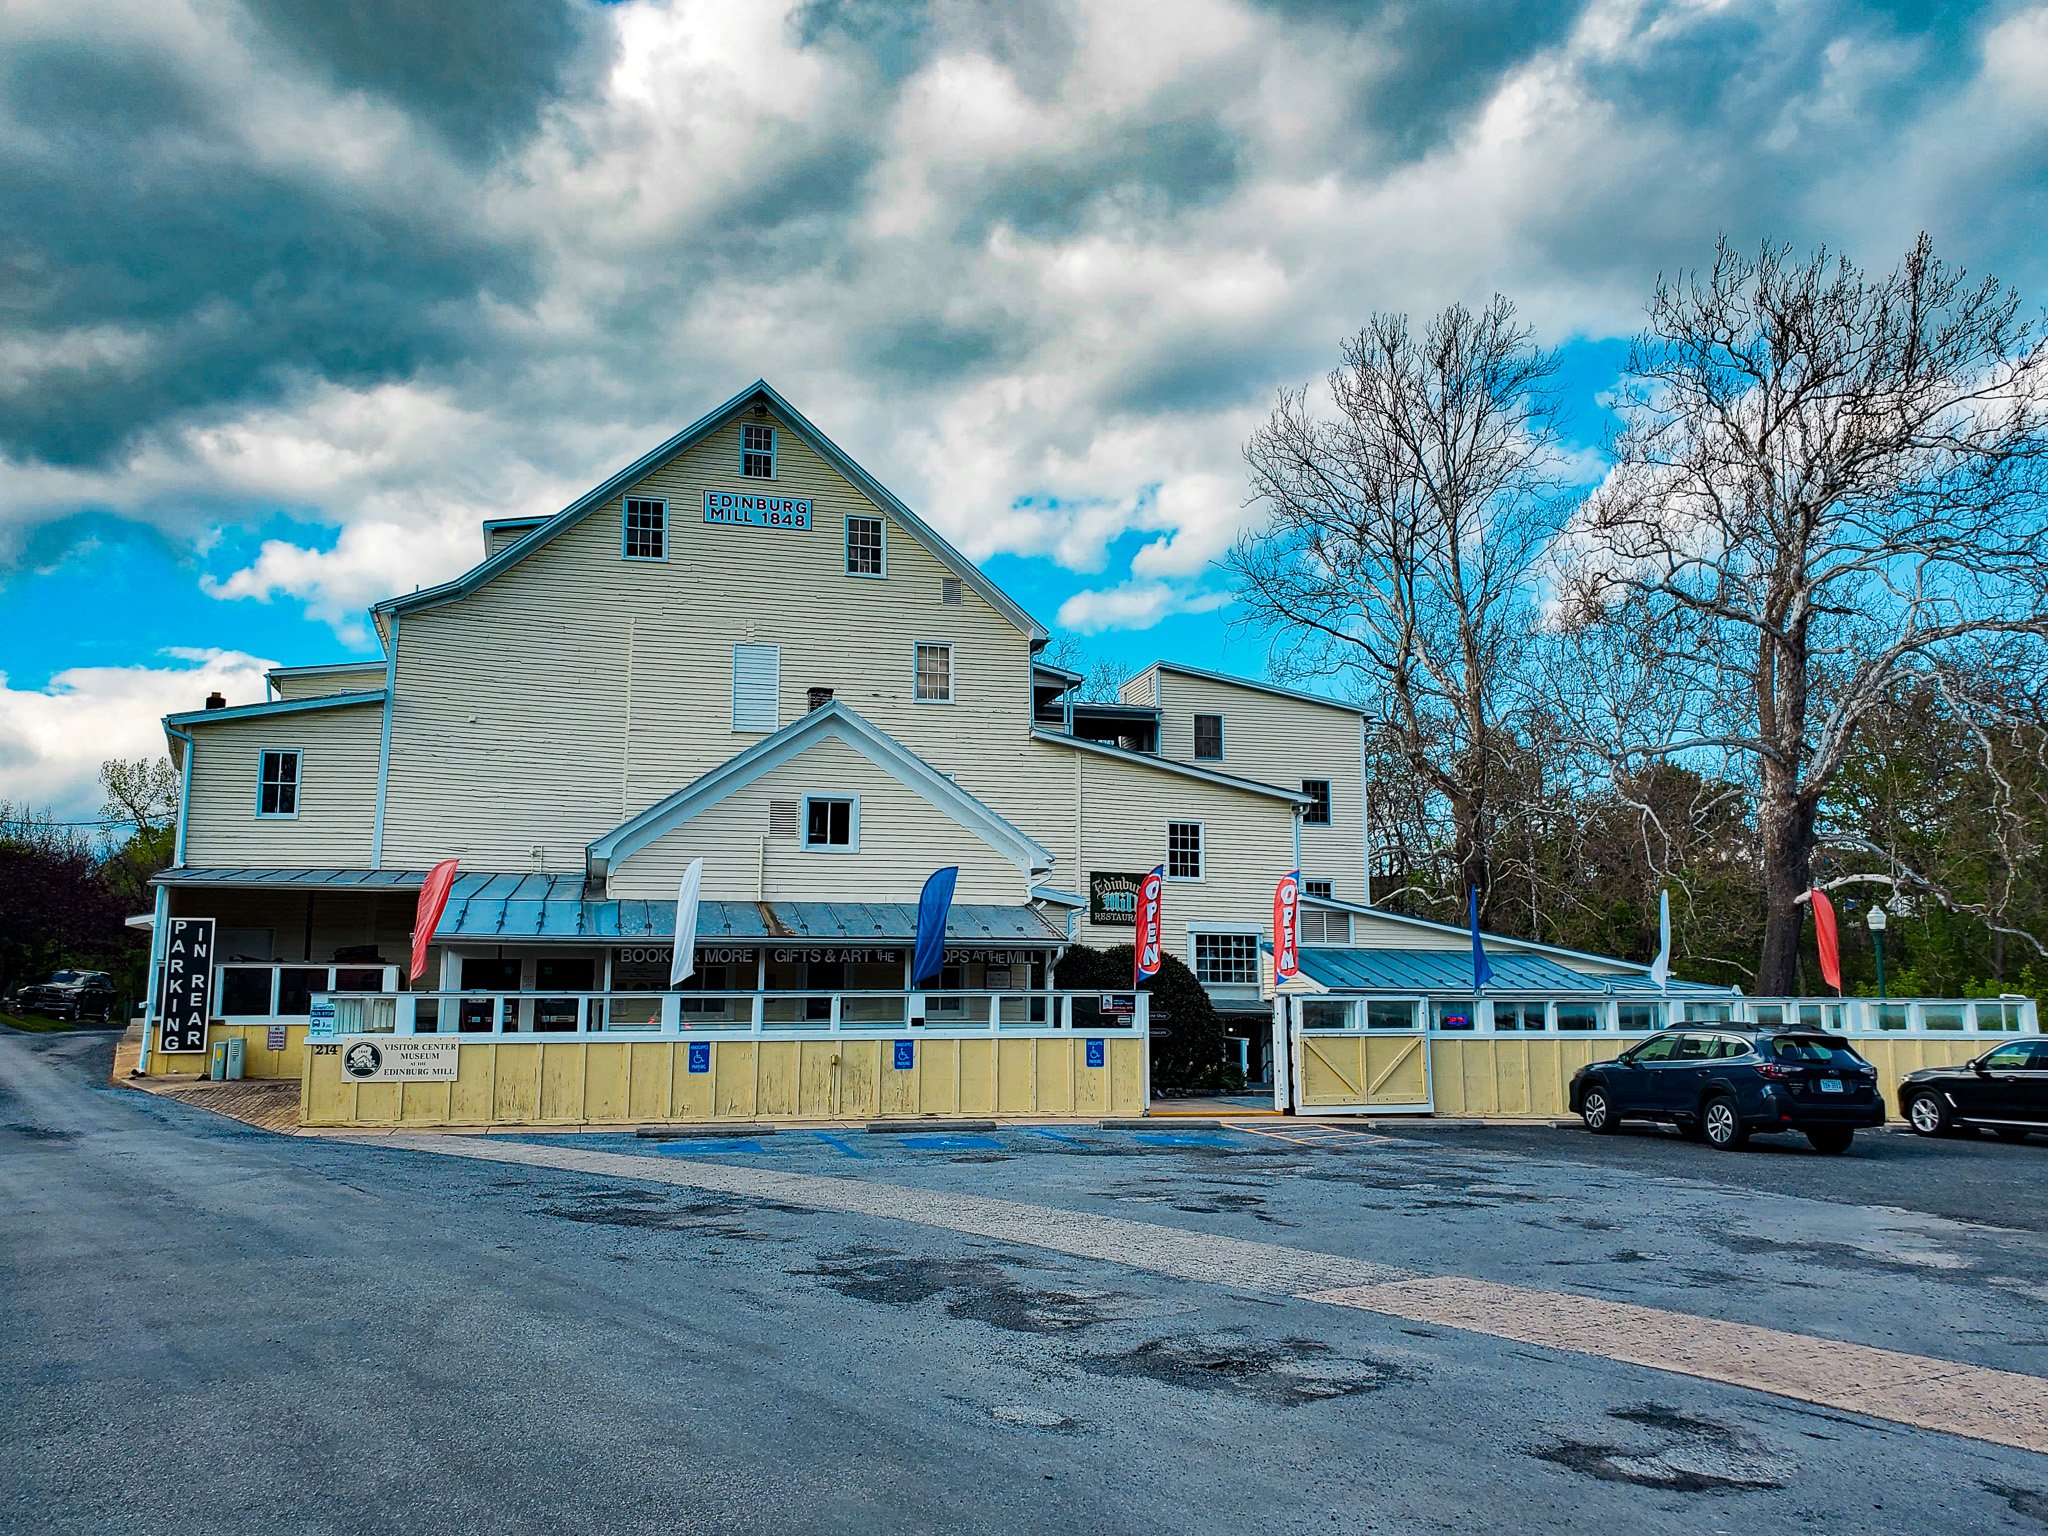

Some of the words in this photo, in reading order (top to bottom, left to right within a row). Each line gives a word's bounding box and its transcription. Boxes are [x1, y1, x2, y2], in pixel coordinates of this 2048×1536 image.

[709, 494, 807, 514] EDINBURG
[710, 508, 752, 523] MILL
[762, 512, 805, 527] 1848
[1143, 880, 1160, 966] OPEN
[1280, 884, 1296, 970] OPEN
[193, 927, 207, 958] IN
[620, 948, 672, 963] BOOK
[704, 949, 753, 963] MORE
[774, 949, 821, 963] GIFTS
[824, 949, 836, 963] &
[839, 949, 872, 963] ART
[875, 949, 895, 963] THE
[972, 950, 986, 962] AT
[986, 950, 1005, 964] THE
[1006, 950, 1039, 964] MILL
[164, 921, 187, 1050] PARKING
[187, 974, 205, 1045] REAR
[315, 1045, 338, 1055] 214
[384, 1043, 420, 1051] VISITOR
[421, 1043, 457, 1051] CENTER
[400, 1052, 440, 1060] MUSEUM
[384, 1068, 429, 1076] EDINBURG
